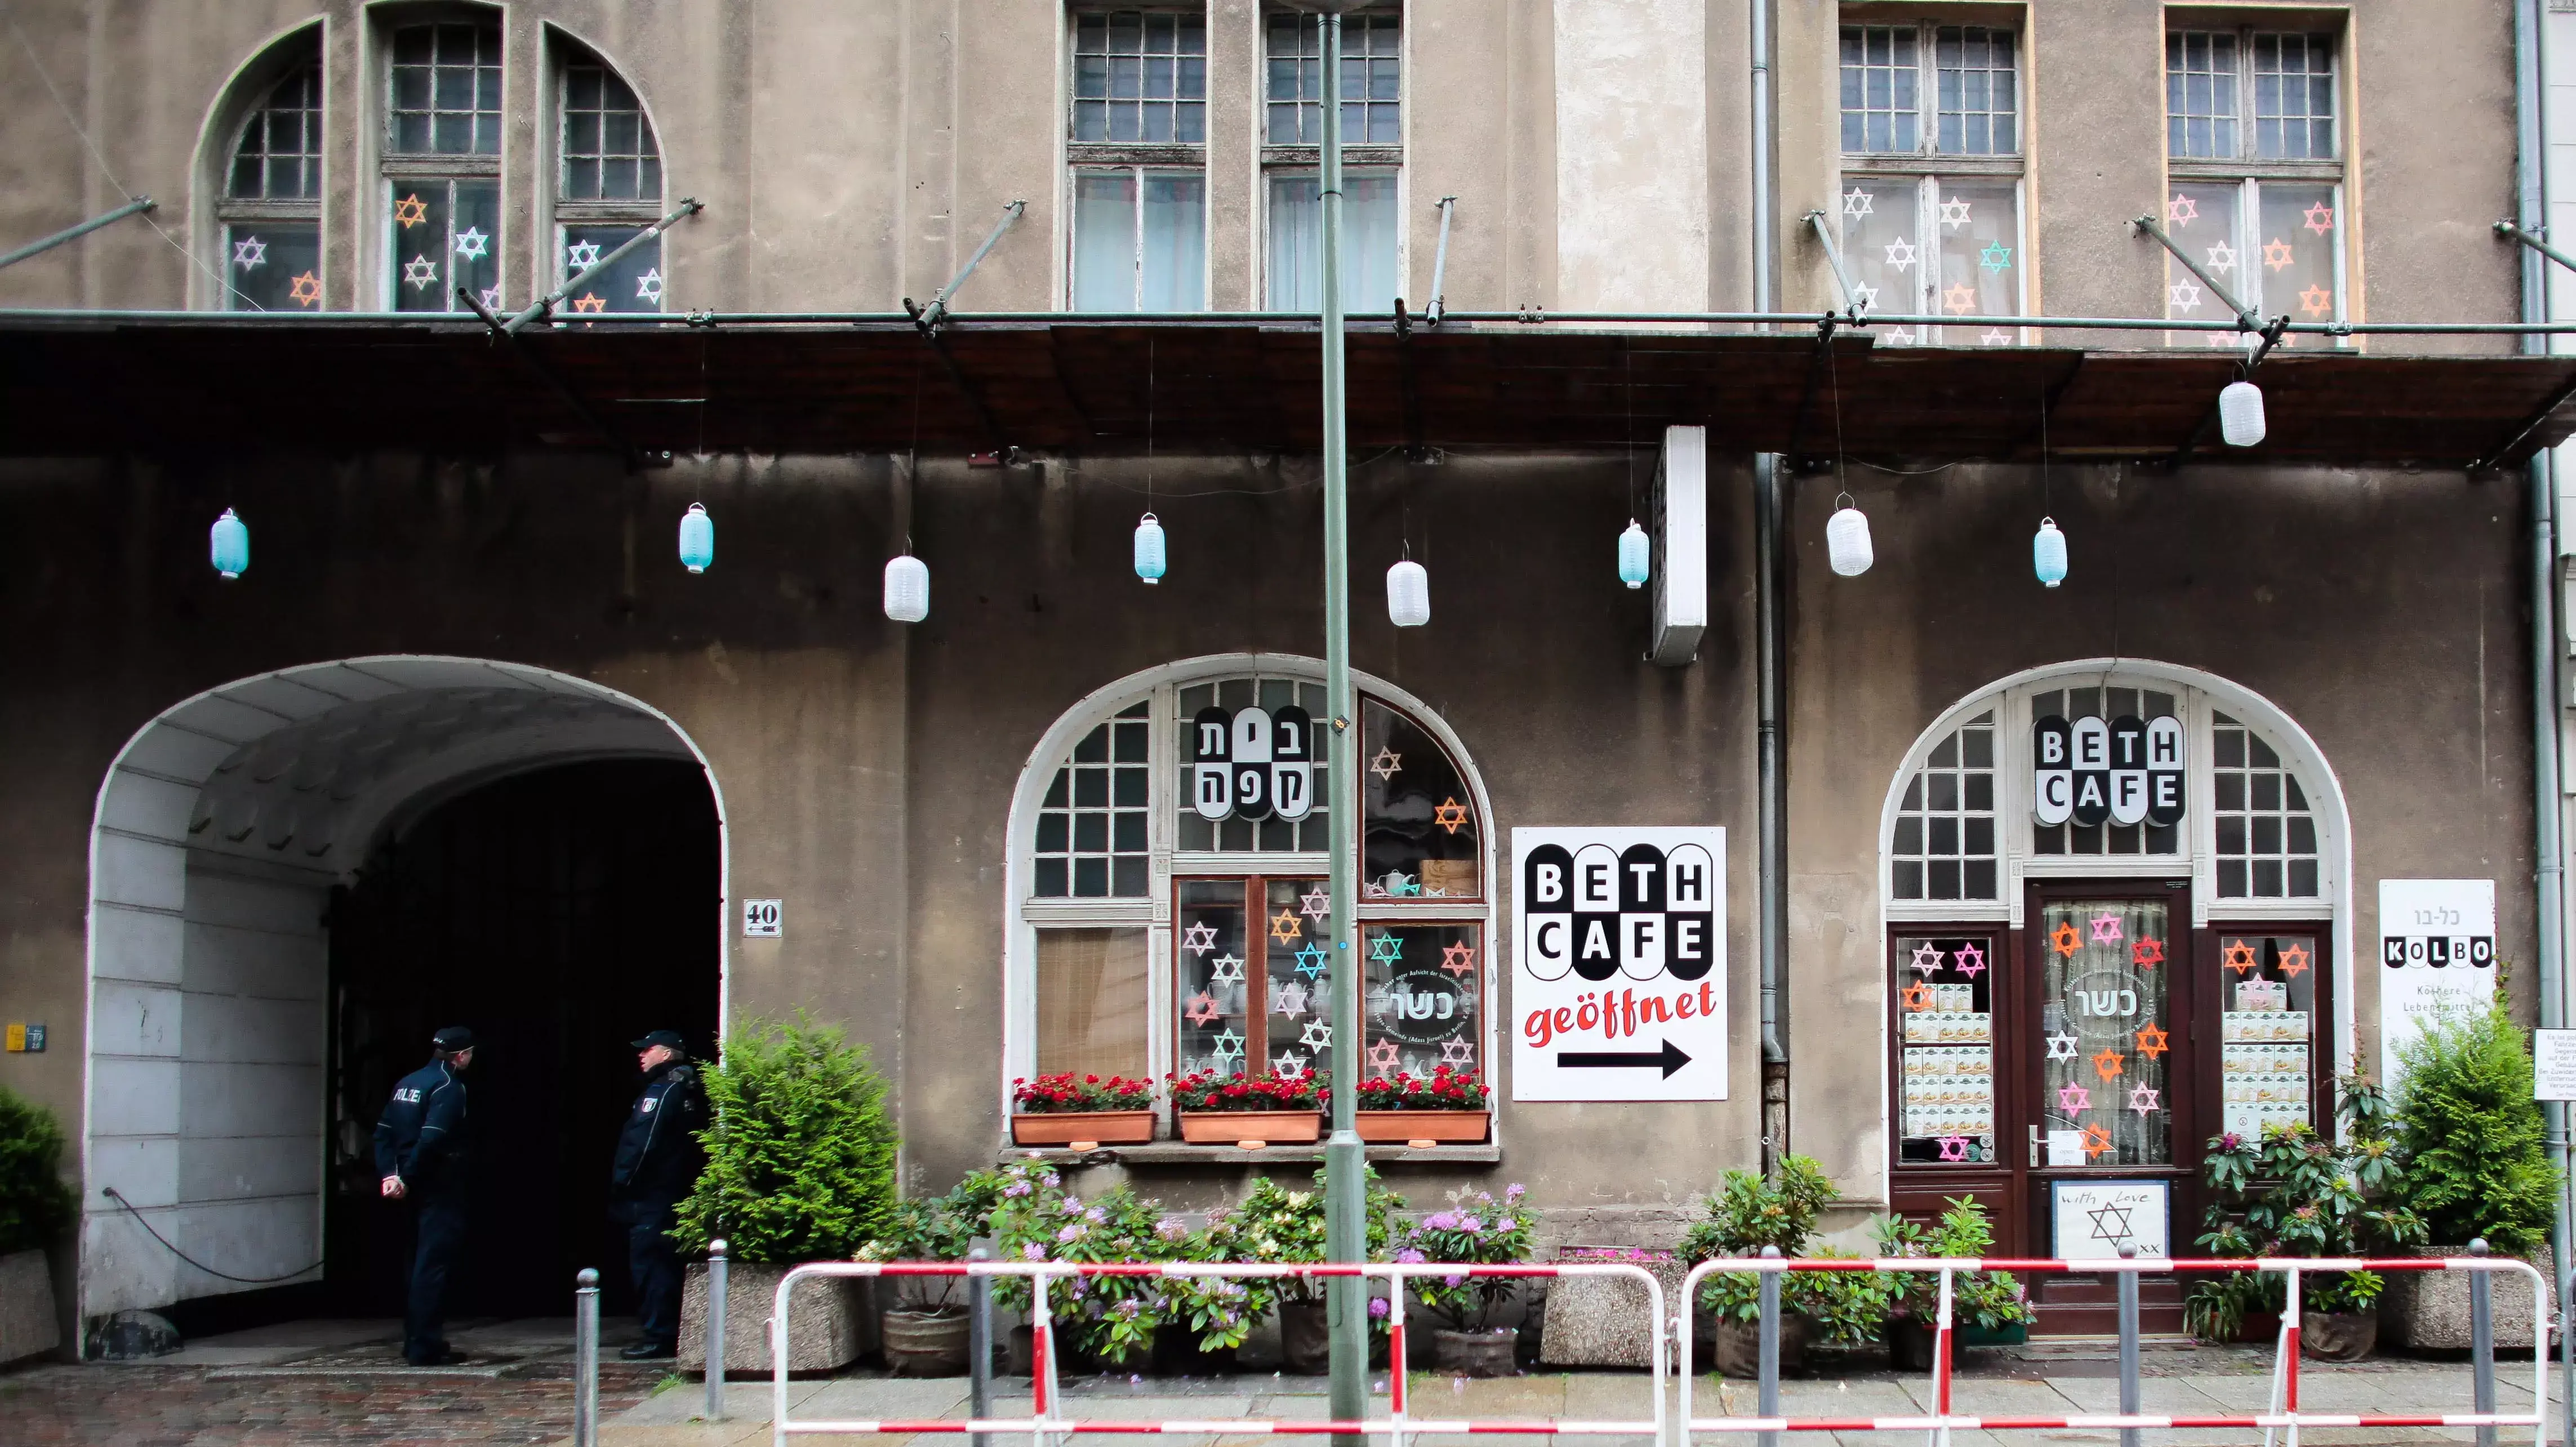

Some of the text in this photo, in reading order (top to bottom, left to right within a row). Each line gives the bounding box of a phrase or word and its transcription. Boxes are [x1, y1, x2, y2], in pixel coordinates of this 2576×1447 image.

[1200, 722, 1301, 755] בית
[2043, 731, 2175, 763] BETH
[1203, 770, 1302, 809] קפה
[2046, 775, 2177, 807] CAFE
[1537, 864, 1702, 902] BETH
[747, 905, 777, 924] 40
[1537, 920, 1701, 959] CAFE
[2388, 941, 2489, 960] KOLBO
[1390, 992, 1453, 1019] כשר
[1525, 981, 1716, 1048] geöffnet
[2075, 989, 2137, 1016] כשר
[2062, 1191, 2096, 1205] with
